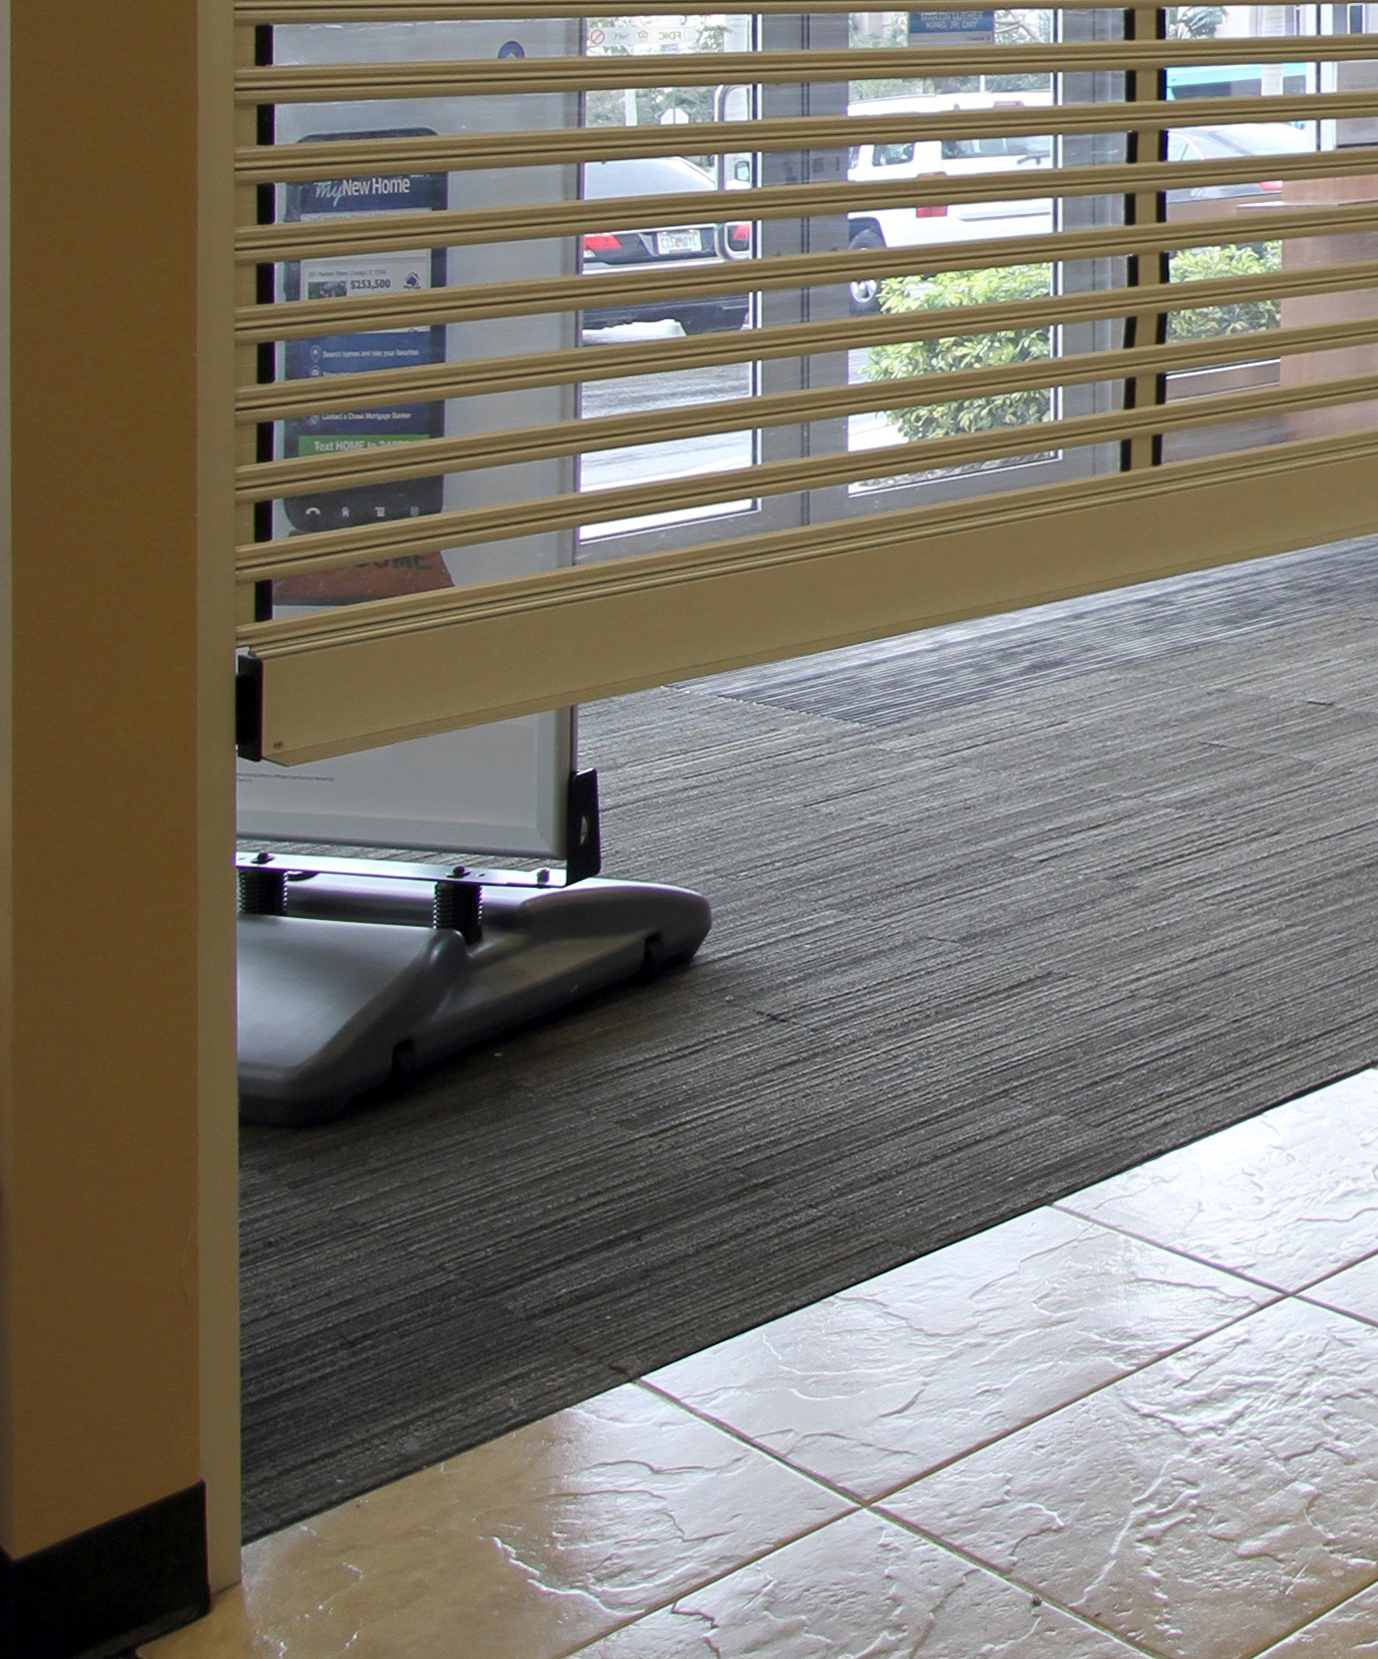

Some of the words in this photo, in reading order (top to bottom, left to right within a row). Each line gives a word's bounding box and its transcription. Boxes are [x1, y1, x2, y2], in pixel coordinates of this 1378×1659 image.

[372, 177, 410, 195] Home
[350, 278, 391, 291] $253,500
[323, 350, 340, 358] Search
[342, 350, 360, 358] homes
[361, 349, 371, 357] and
[383, 350, 395, 358] your
[314, 441, 333, 451] Text
[335, 441, 365, 451] HOME
